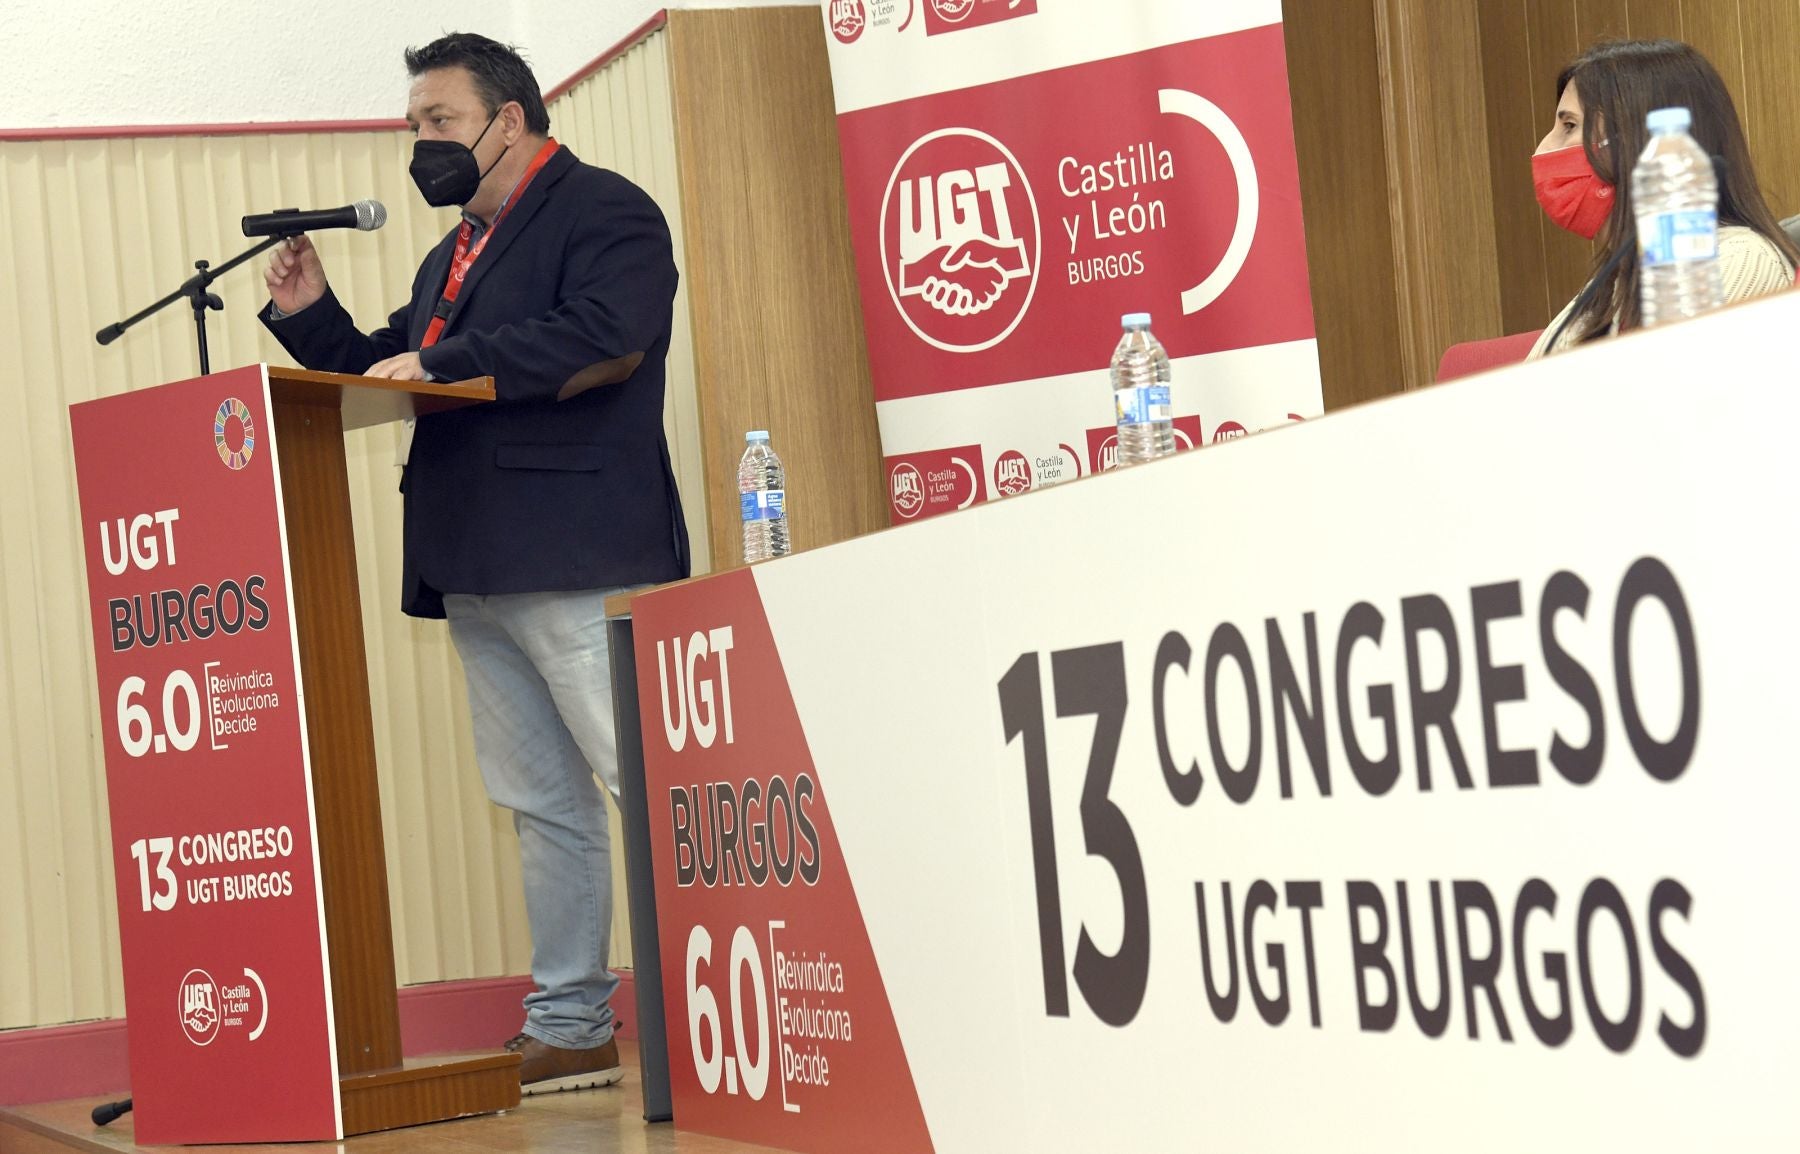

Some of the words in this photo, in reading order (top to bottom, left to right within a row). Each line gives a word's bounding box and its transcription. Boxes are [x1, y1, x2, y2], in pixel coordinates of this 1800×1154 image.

[878, 4, 895, 15] León
[1058, 142, 1175, 197] Castilla
[899, 162, 1015, 259] UGT
[1062, 214, 1080, 254] y
[1091, 192, 1166, 239] León
[1068, 250, 1145, 285] BURGOS
[927, 469, 957, 482] Castilla
[998, 458, 1026, 482] UGT
[1035, 456, 1063, 468] Castilla
[1037, 472, 1042, 481] y
[1043, 467, 1061, 479] León
[894, 472, 918, 495] UGT
[929, 485, 934, 495] y
[935, 481, 955, 493] León
[100, 509, 179, 576] UGT
[109, 575, 270, 652] BURGOS
[210, 669, 273, 694] Reivindica
[656, 625, 734, 753] UGT
[117, 669, 201, 758] 6.0
[213, 691, 279, 715] Evoluciona
[214, 713, 257, 736] Decide
[997, 640, 1151, 1030] 13
[1152, 555, 1702, 808] CONGRESO
[669, 772, 822, 888] BURGOS
[130, 836, 178, 912] 13
[178, 825, 293, 867] CONGRESO
[186, 877, 219, 905] UGT
[223, 870, 293, 902] BURGOS
[776, 951, 844, 993] Reivindica
[1194, 877, 1324, 1030] UGT
[1344, 875, 1708, 1060] BURGOS
[184, 983, 212, 1013] UGT
[221, 985, 250, 999] Castilla
[223, 1003, 228, 1016] y
[229, 999, 249, 1012] León
[686, 924, 770, 1102] 6.0
[780, 997, 852, 1042] Evoluciona
[784, 1043, 829, 1087] Decide
